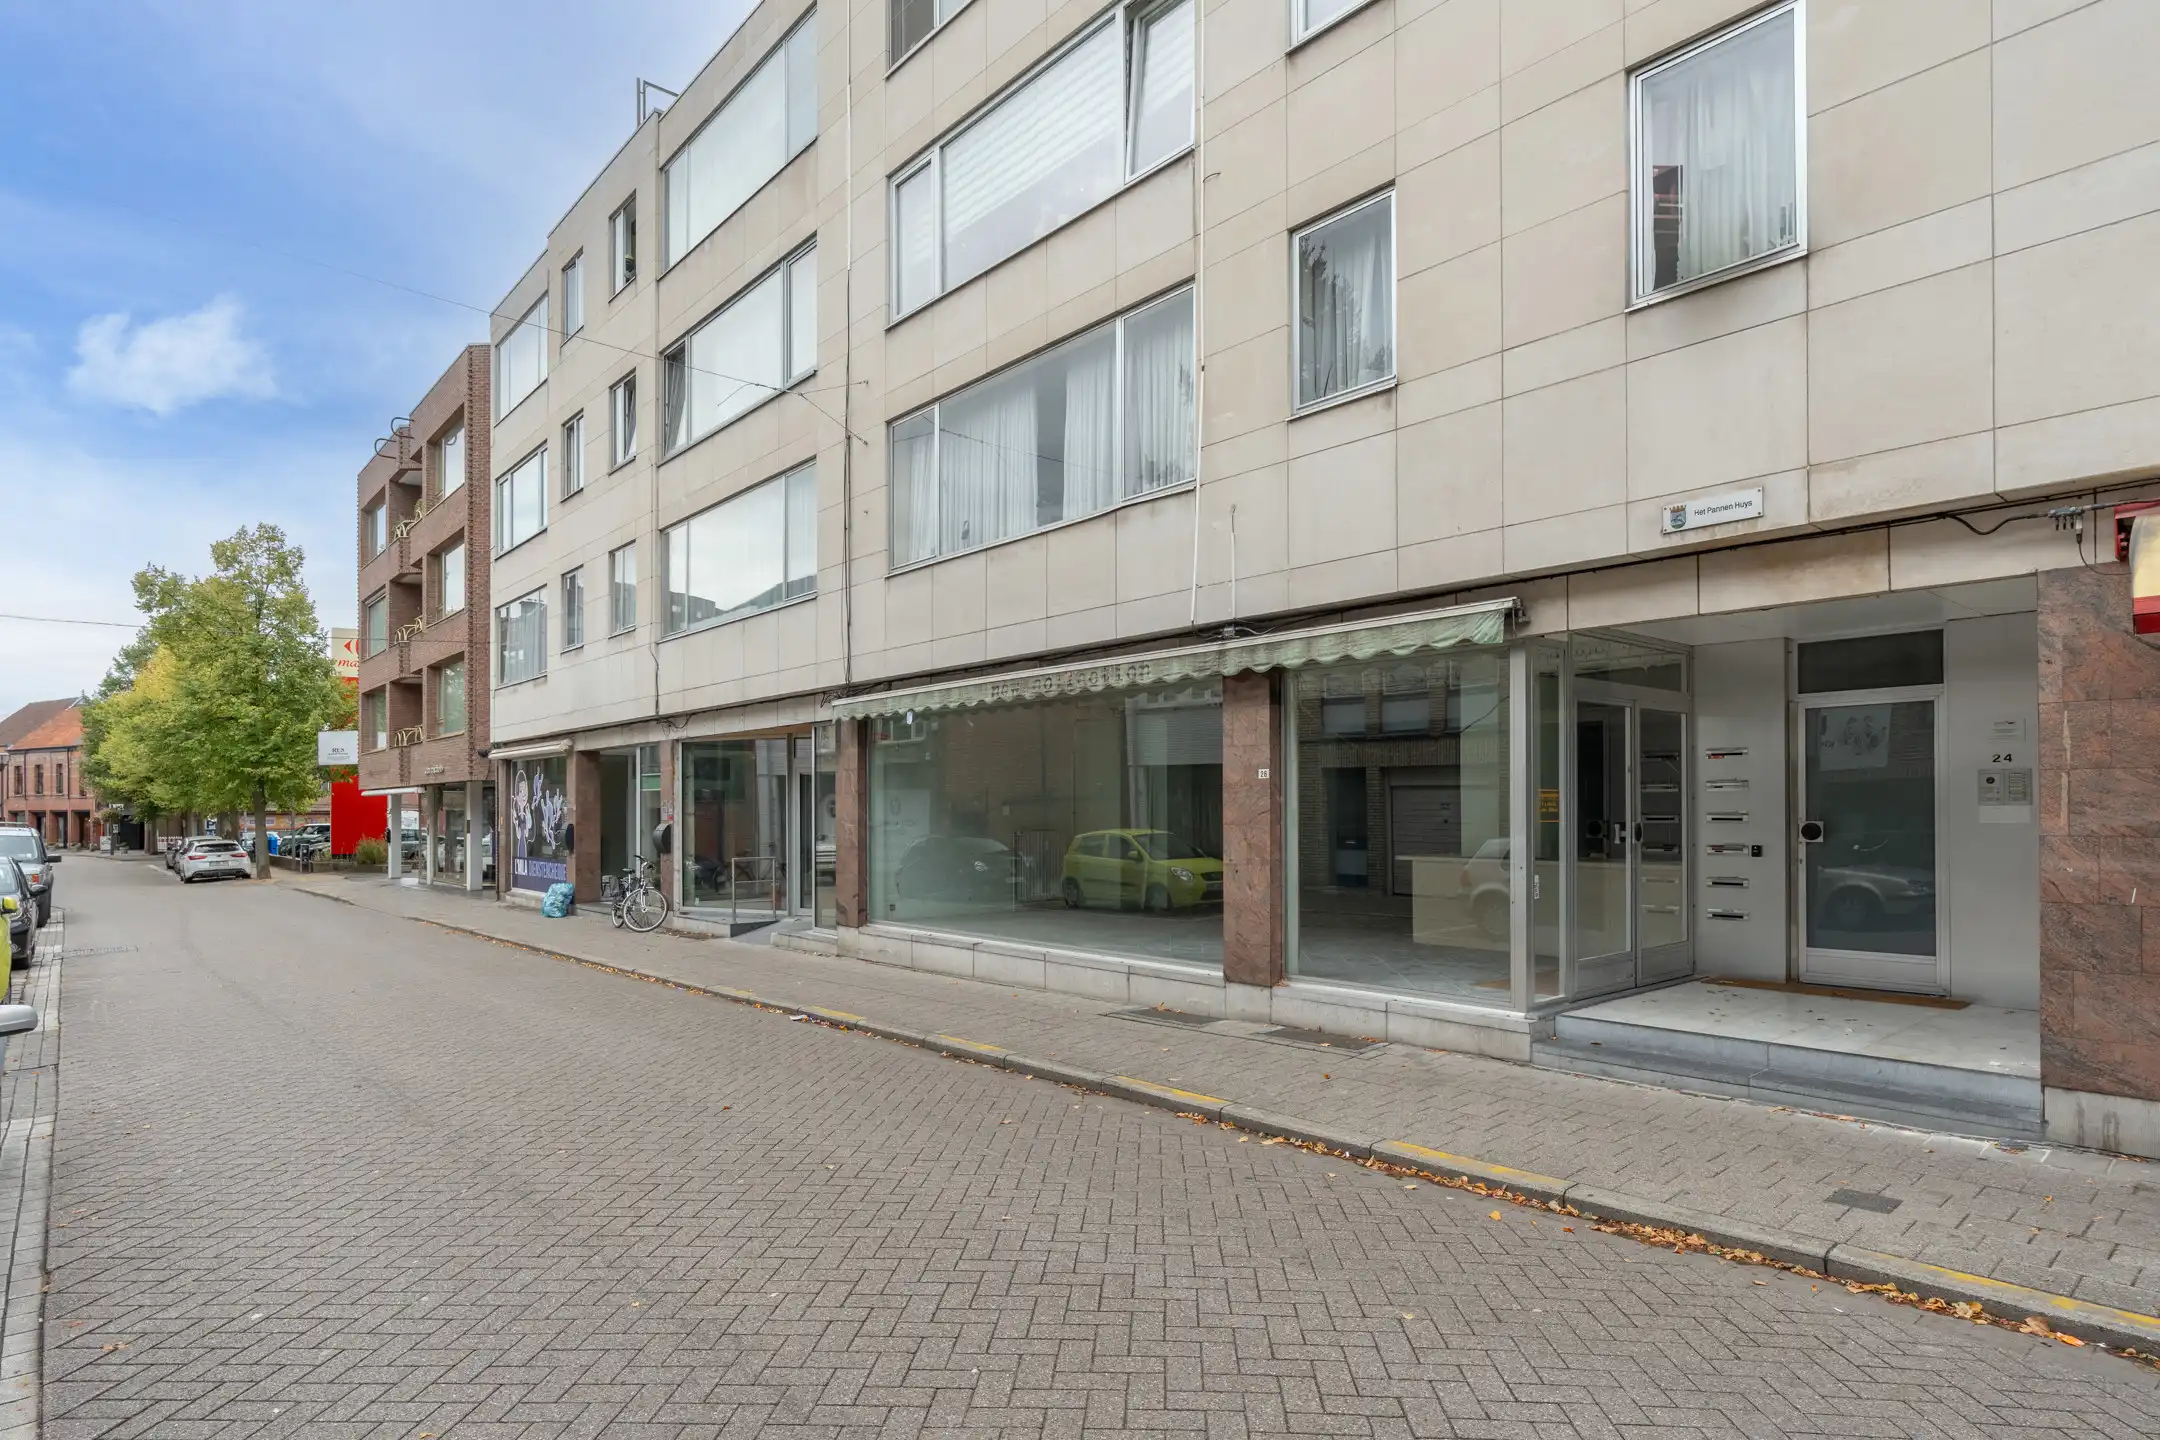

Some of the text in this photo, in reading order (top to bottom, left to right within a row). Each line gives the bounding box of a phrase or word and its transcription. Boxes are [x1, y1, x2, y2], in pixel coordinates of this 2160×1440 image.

[1694, 500, 1753, 516] Het Pannen Huys
[1992, 753, 2013, 763] 24
